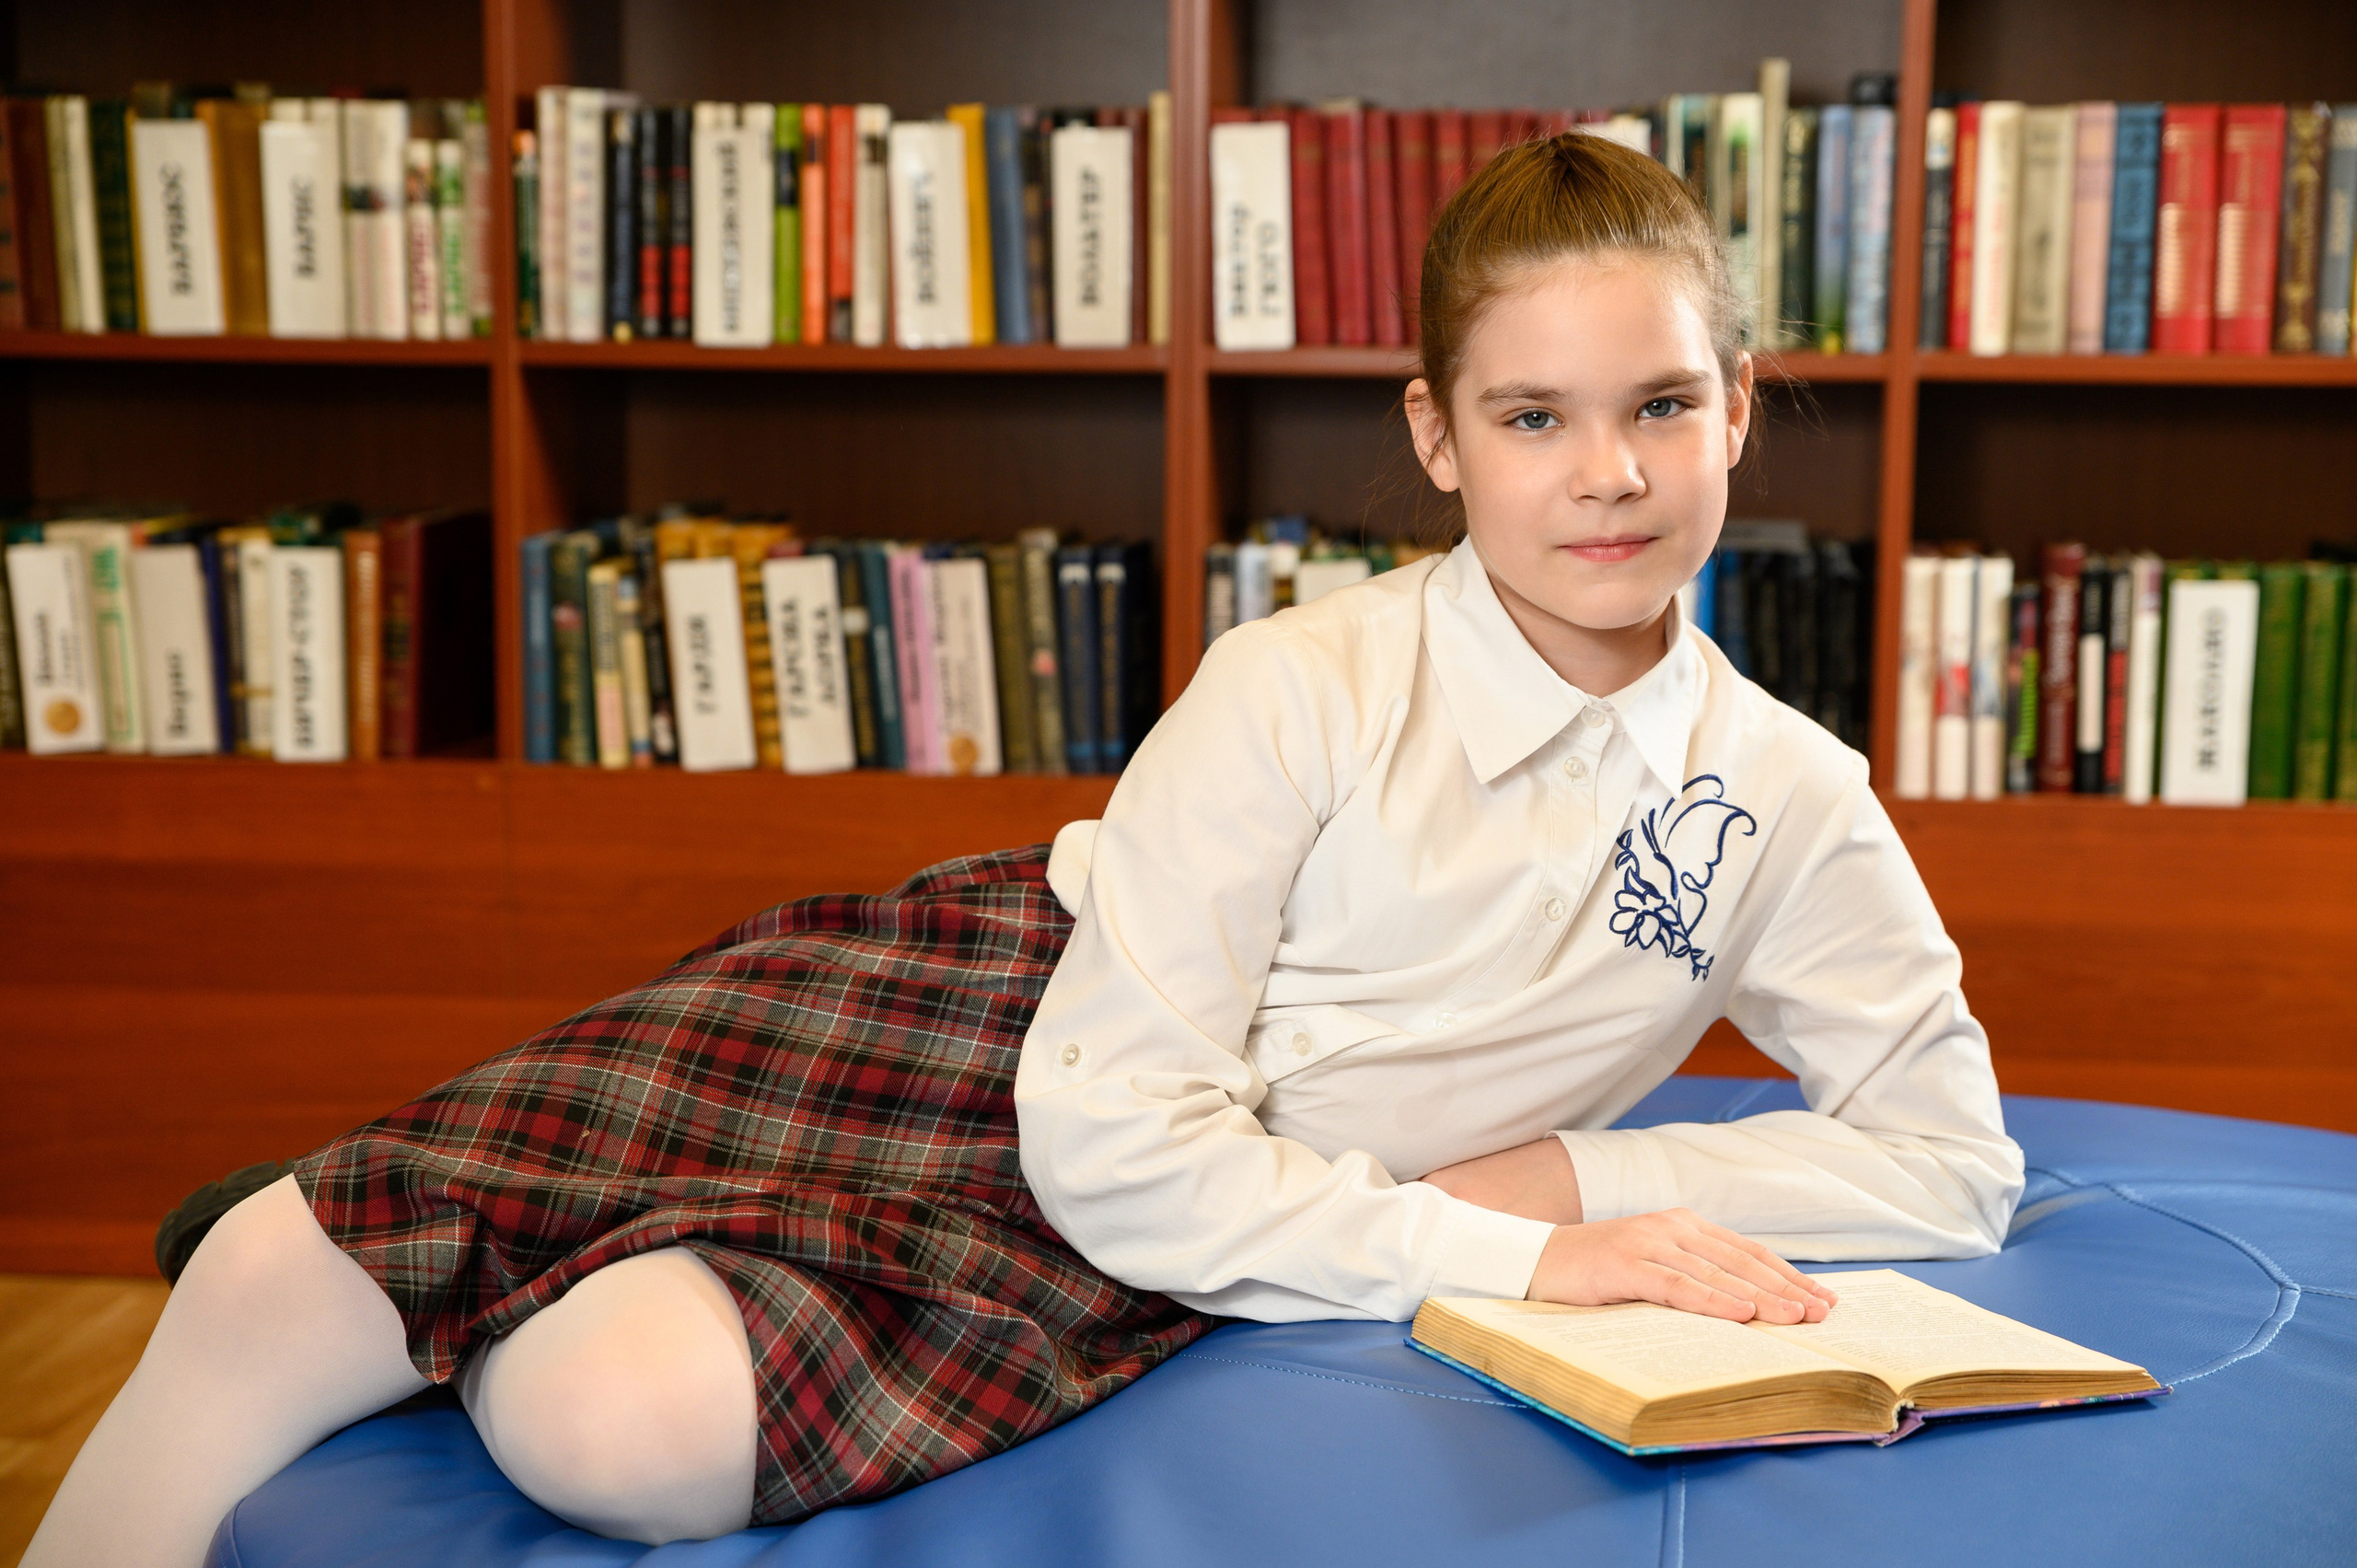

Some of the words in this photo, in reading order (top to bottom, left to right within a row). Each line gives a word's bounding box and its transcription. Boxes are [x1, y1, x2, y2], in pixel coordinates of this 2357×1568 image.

[159, 163, 192, 296] БАРБЮС
[908, 171, 936, 305] ВОЙНИЧ
[1076, 168, 1100, 308] ВОЛЬТЕР
[1228, 204, 1250, 318] Виктор
[1258, 220, 1281, 318] ГЮГО
[288, 566, 315, 748] БИЧЕР-СТОУ
[689, 616, 717, 715] ГАРДИ
[781, 600, 810, 718] ГАРСИА
[812, 605, 838, 707] ЛОРКА
